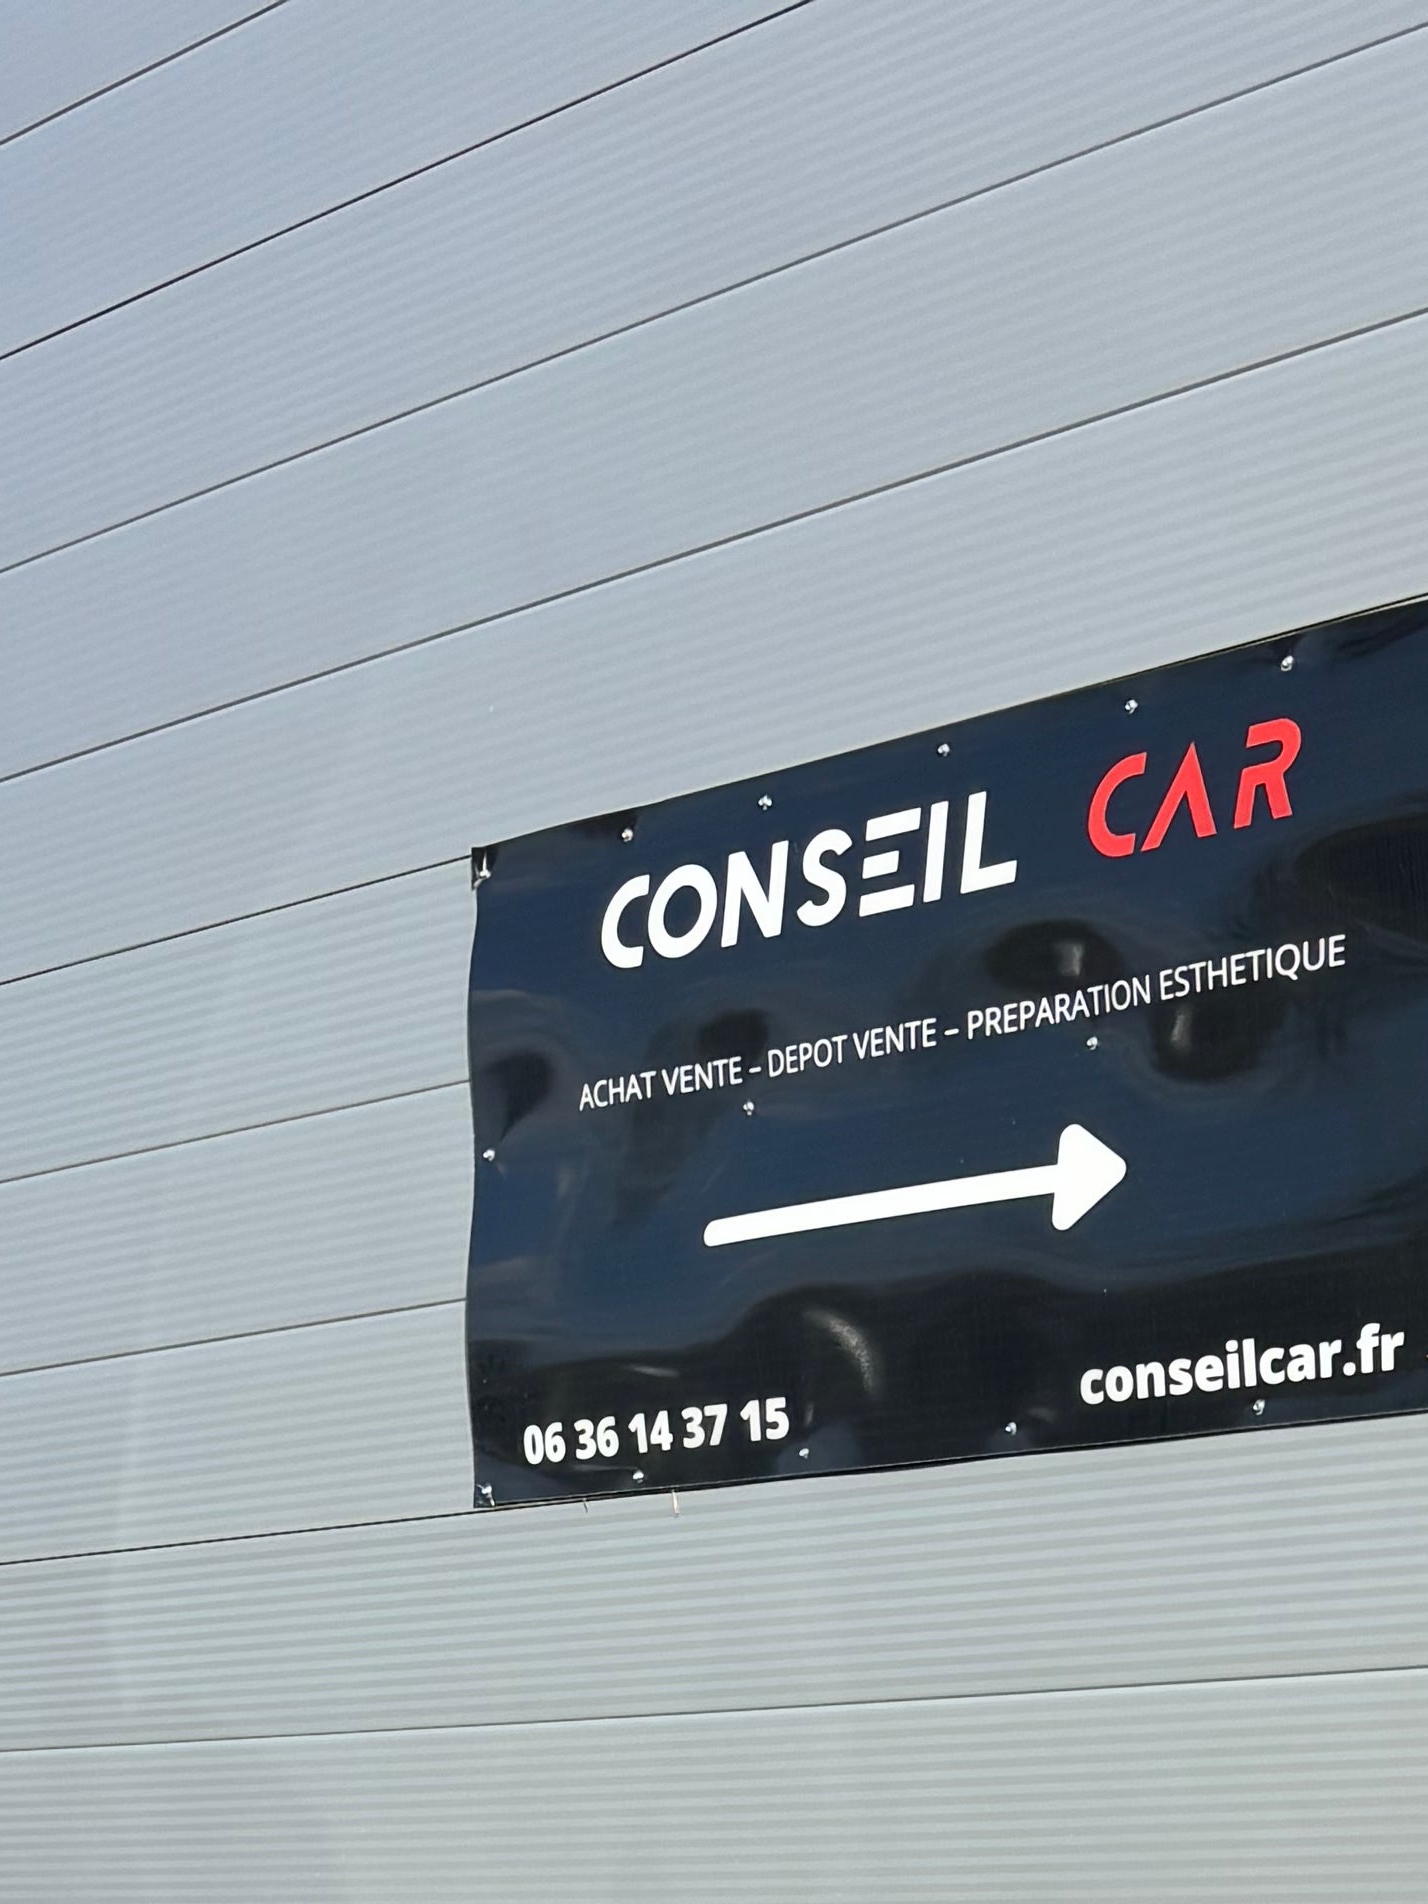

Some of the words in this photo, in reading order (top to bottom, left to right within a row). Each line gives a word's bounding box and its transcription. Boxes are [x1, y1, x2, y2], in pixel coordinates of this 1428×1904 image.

[600, 790, 1018, 969] CONSEIL
[1085, 717, 1302, 859] CAR
[578, 1070, 657, 1112] ACHAT
[661, 1055, 743, 1096] VENTE
[767, 1034, 849, 1078] DEPOT
[852, 1017, 937, 1060] VENTE
[967, 974, 1151, 1040] PREPARATION
[1159, 933, 1346, 1001] ESTHETIQUE
[1080, 1322, 1405, 1405] conseilcar.fr
[523, 1421, 566, 1465] 06
[573, 1415, 620, 1460] 36
[627, 1410, 674, 1454] 14
[680, 1403, 728, 1449] 37
[739, 1396, 790, 1442] 15
